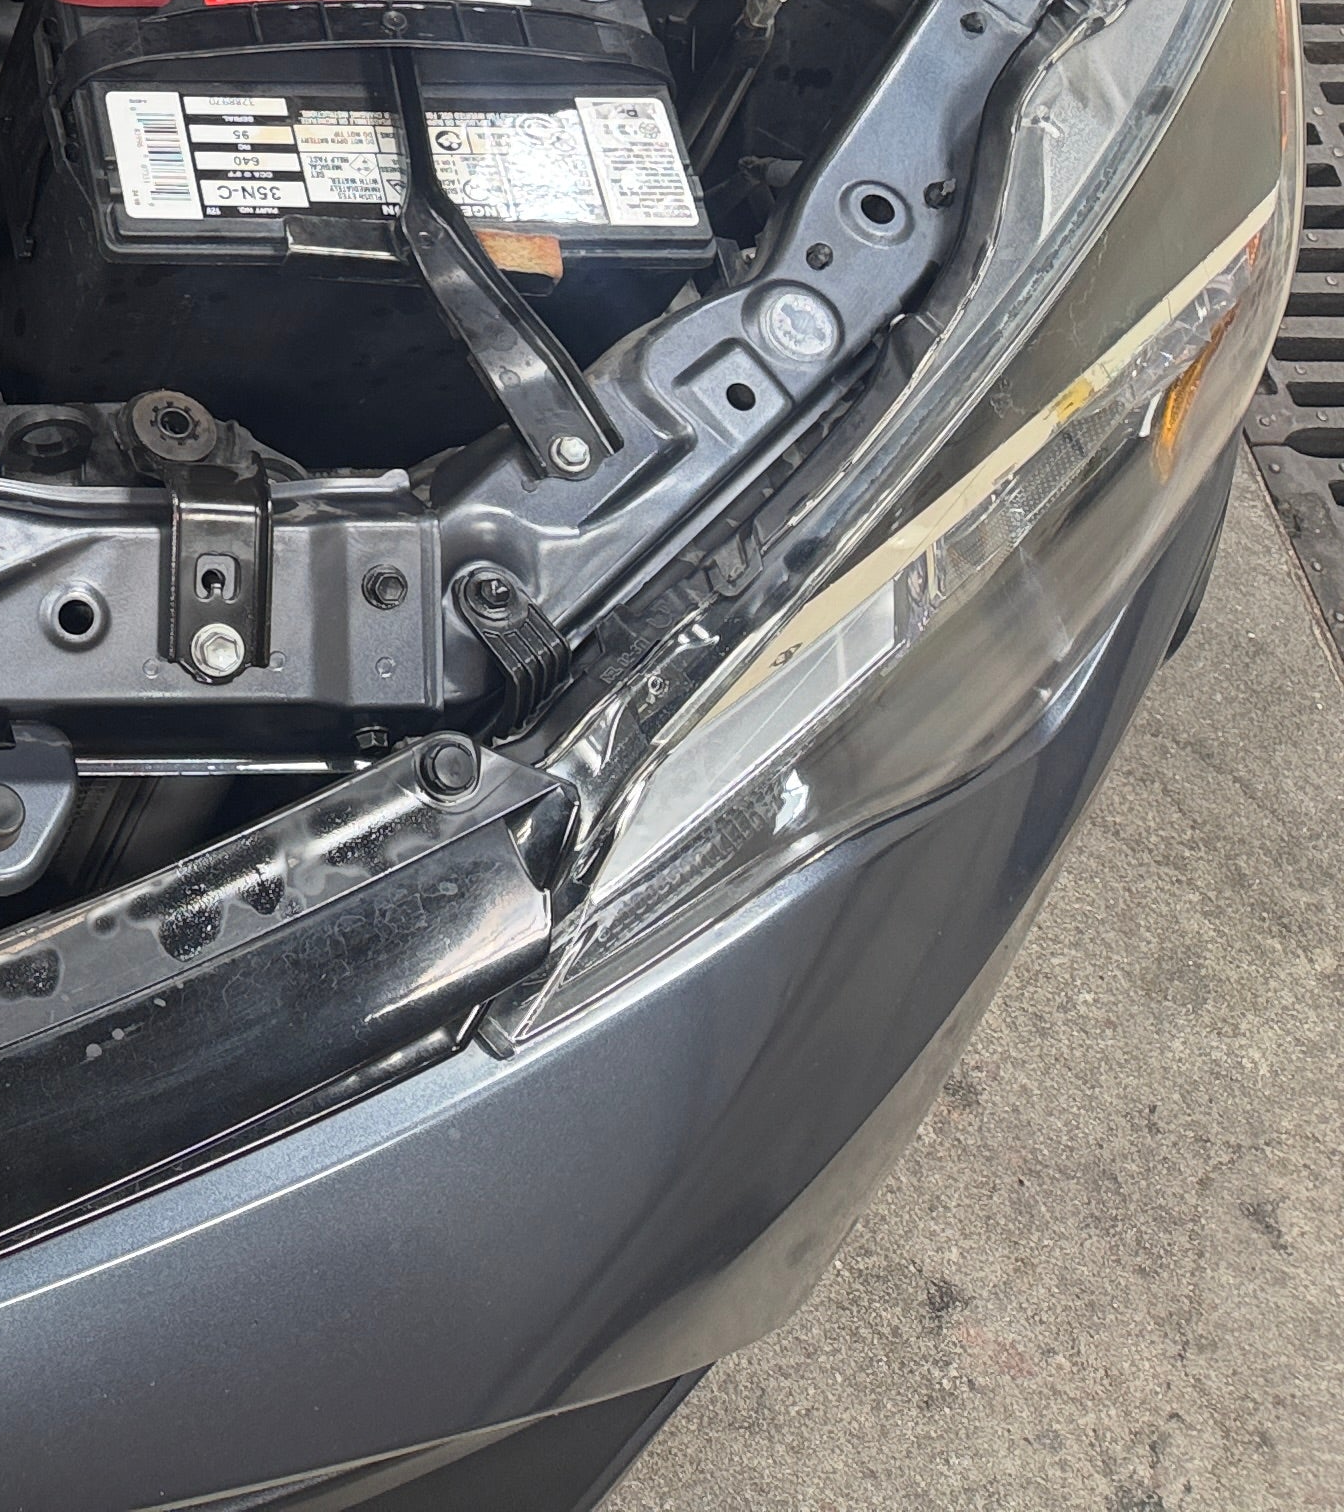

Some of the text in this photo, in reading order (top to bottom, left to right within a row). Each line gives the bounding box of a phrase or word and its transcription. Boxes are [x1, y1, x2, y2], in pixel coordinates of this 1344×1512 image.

[233, 130, 250, 139] 95
[233, 156, 260, 167] 640
[217, 185, 282, 201] 35N-C
[330, 185, 381, 193] IMMEDIATELY
[206, 206, 221, 216] 12V
[237, 206, 254, 214] NO.
